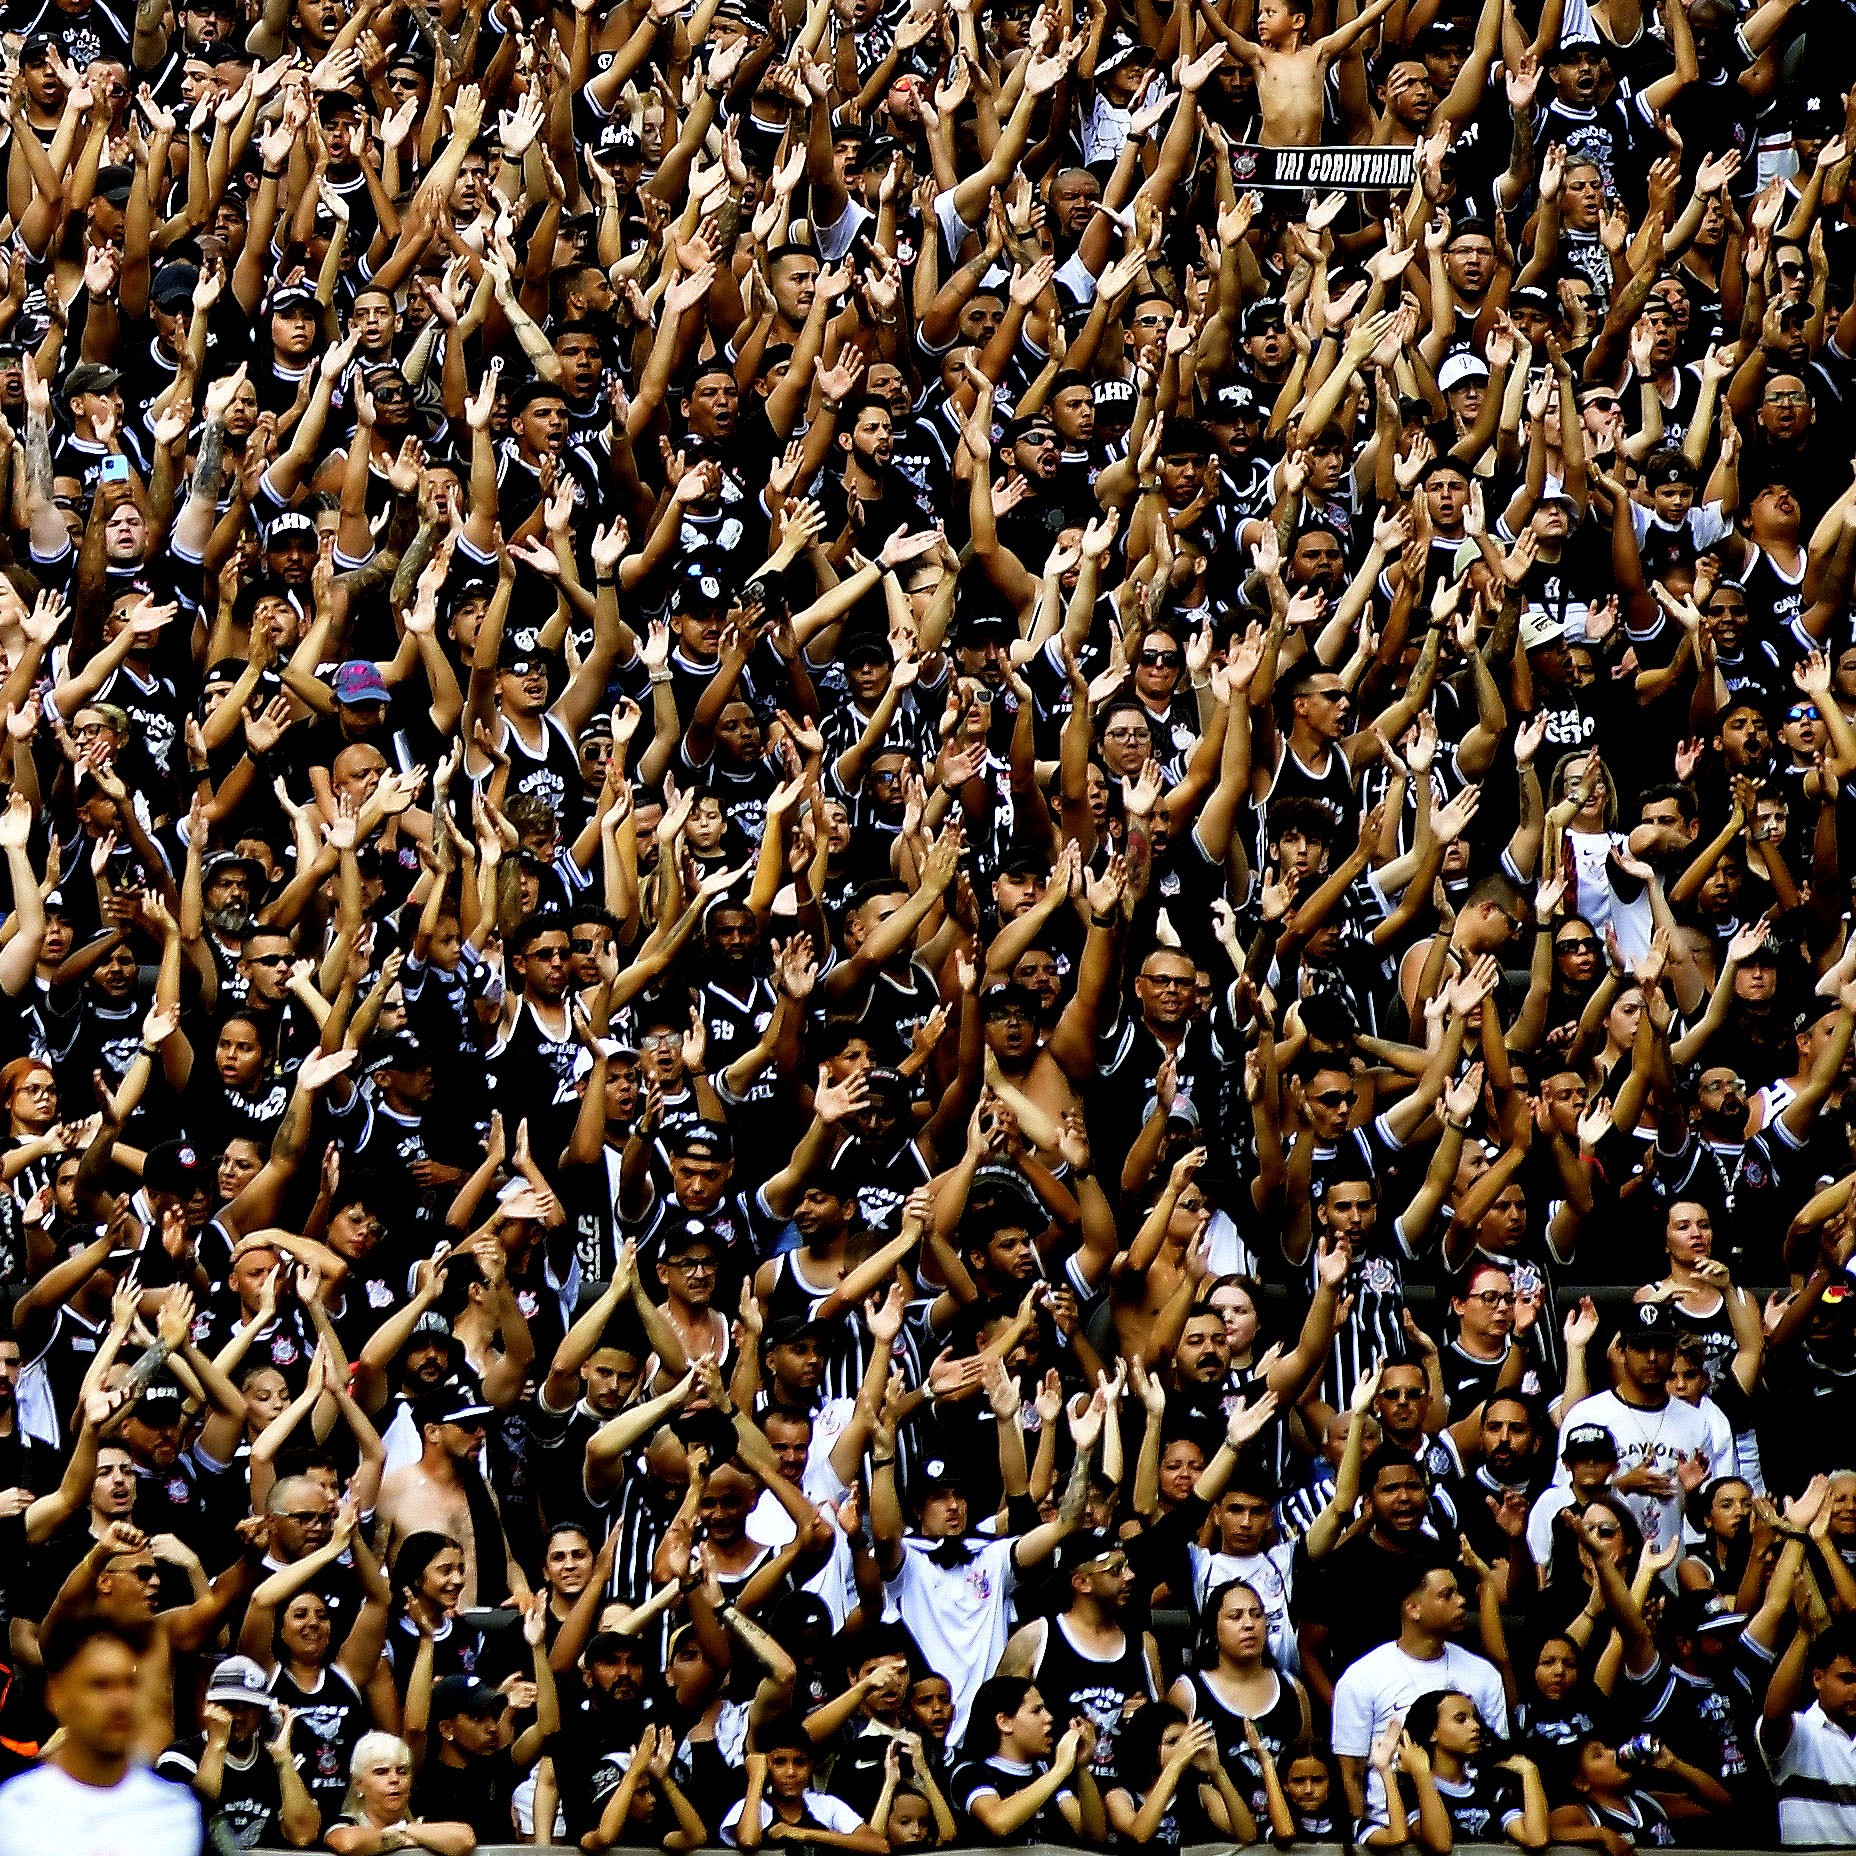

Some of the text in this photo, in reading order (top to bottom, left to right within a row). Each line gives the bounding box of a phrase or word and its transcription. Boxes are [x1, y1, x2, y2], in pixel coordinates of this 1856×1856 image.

[1275, 152, 1305, 180] VAI
[1094, 381, 1133, 403] LHP
[272, 513, 312, 535] LHP
